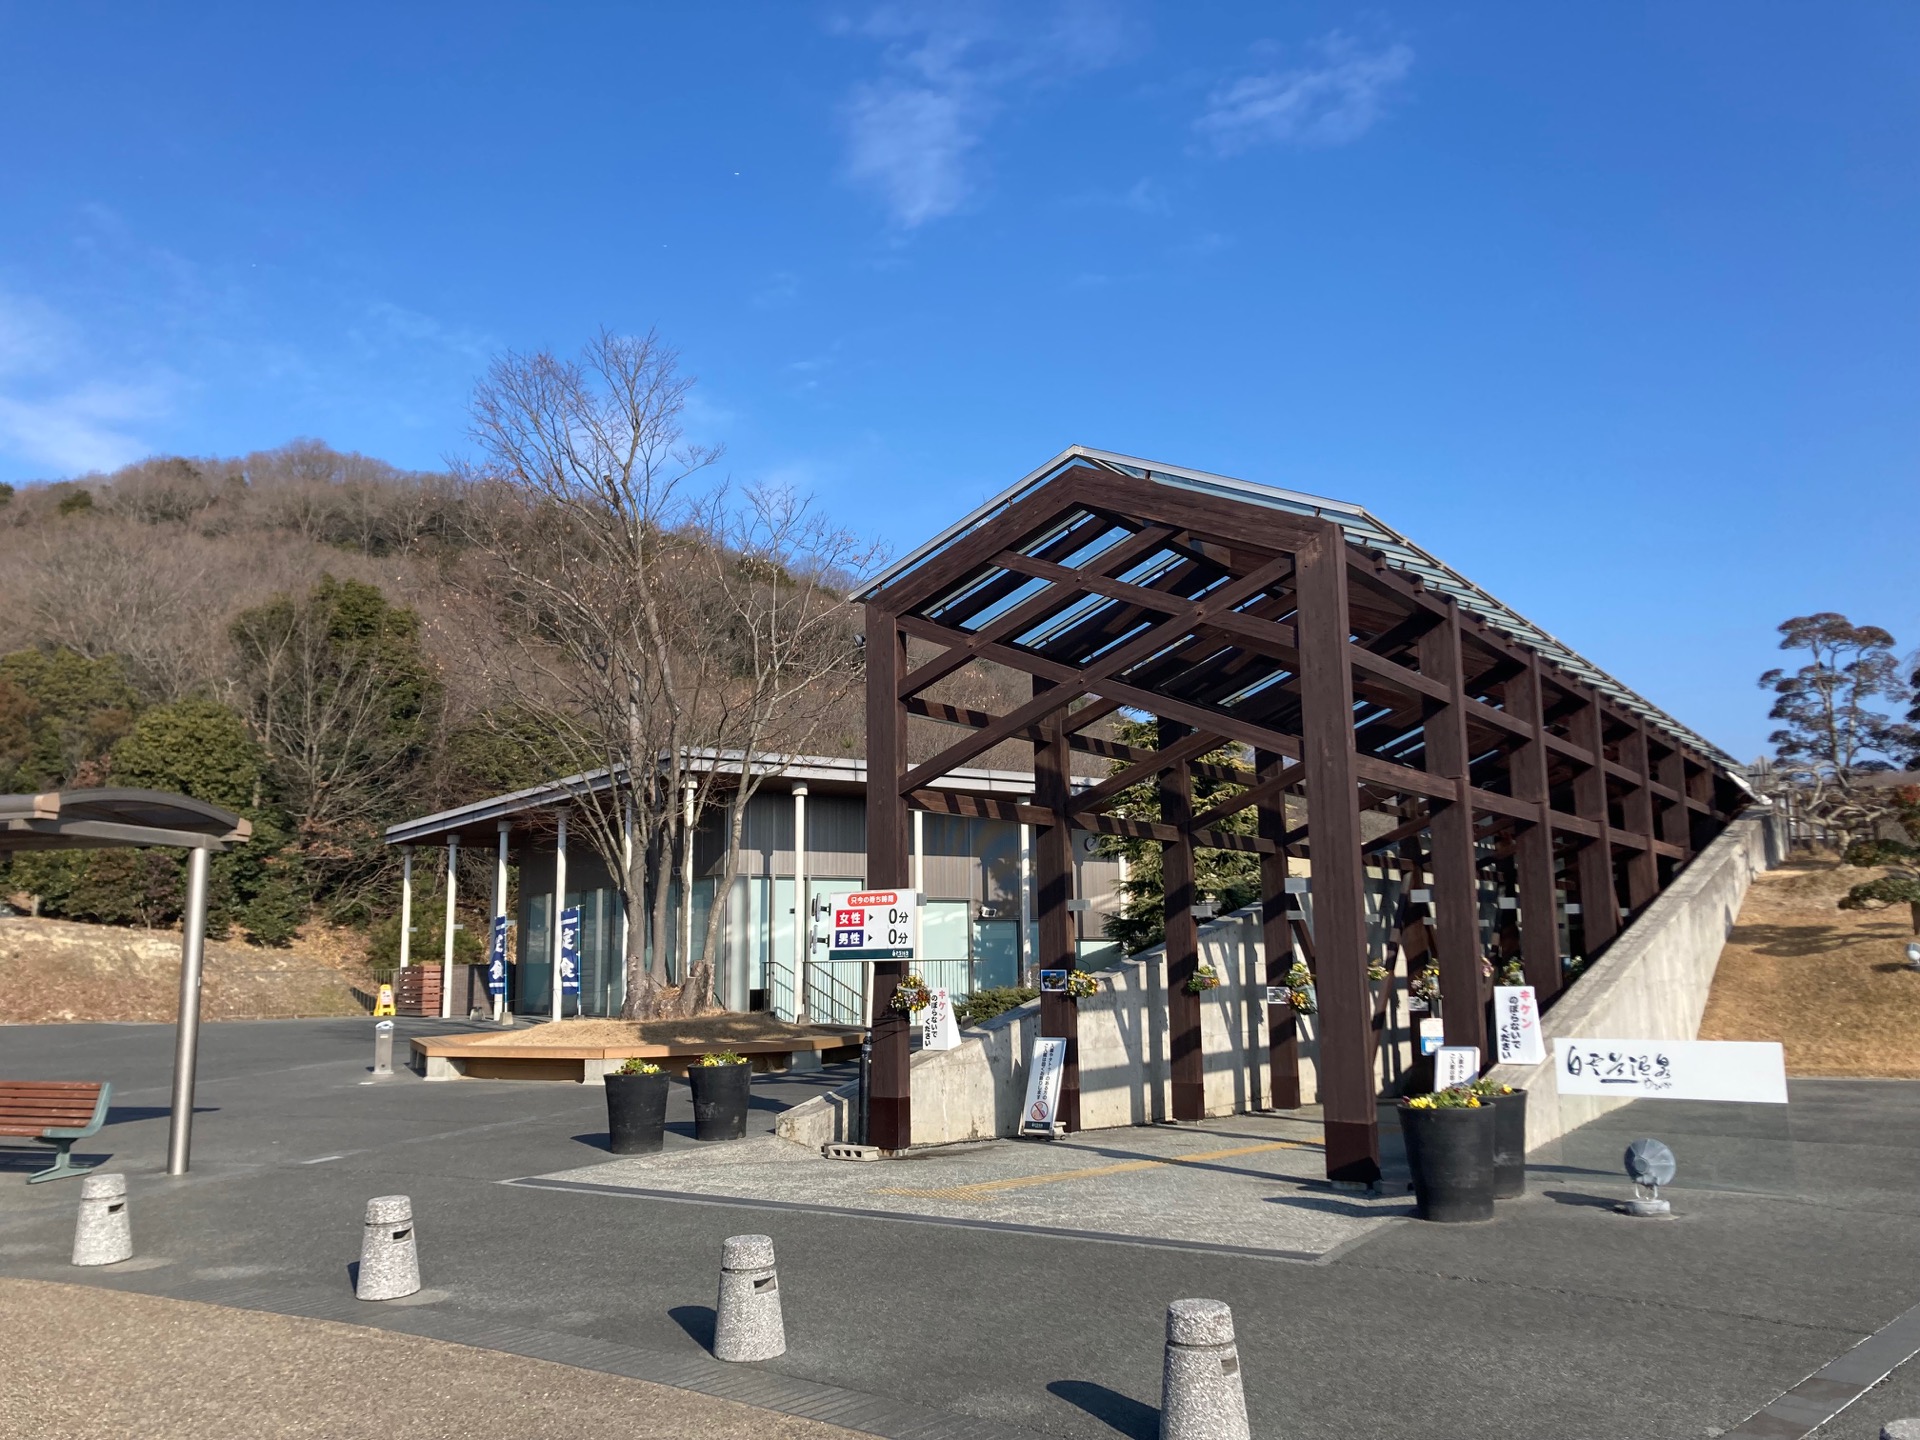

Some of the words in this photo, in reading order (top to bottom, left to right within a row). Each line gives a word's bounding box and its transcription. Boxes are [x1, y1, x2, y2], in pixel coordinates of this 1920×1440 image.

[839, 912, 861, 925] 女性
[888, 908, 909, 924] 0分
[851, 895, 894, 905] 只今の待ち時間
[838, 932, 860, 945] 男性
[888, 929, 908, 945] 0分
[930, 995, 938, 1038] のぼらないで
[938, 990, 946, 1022] キケン
[1508, 996, 1521, 1049] のぼらないで
[1519, 990, 1532, 1029] キケン
[1501, 1025, 1512, 1060] ください
